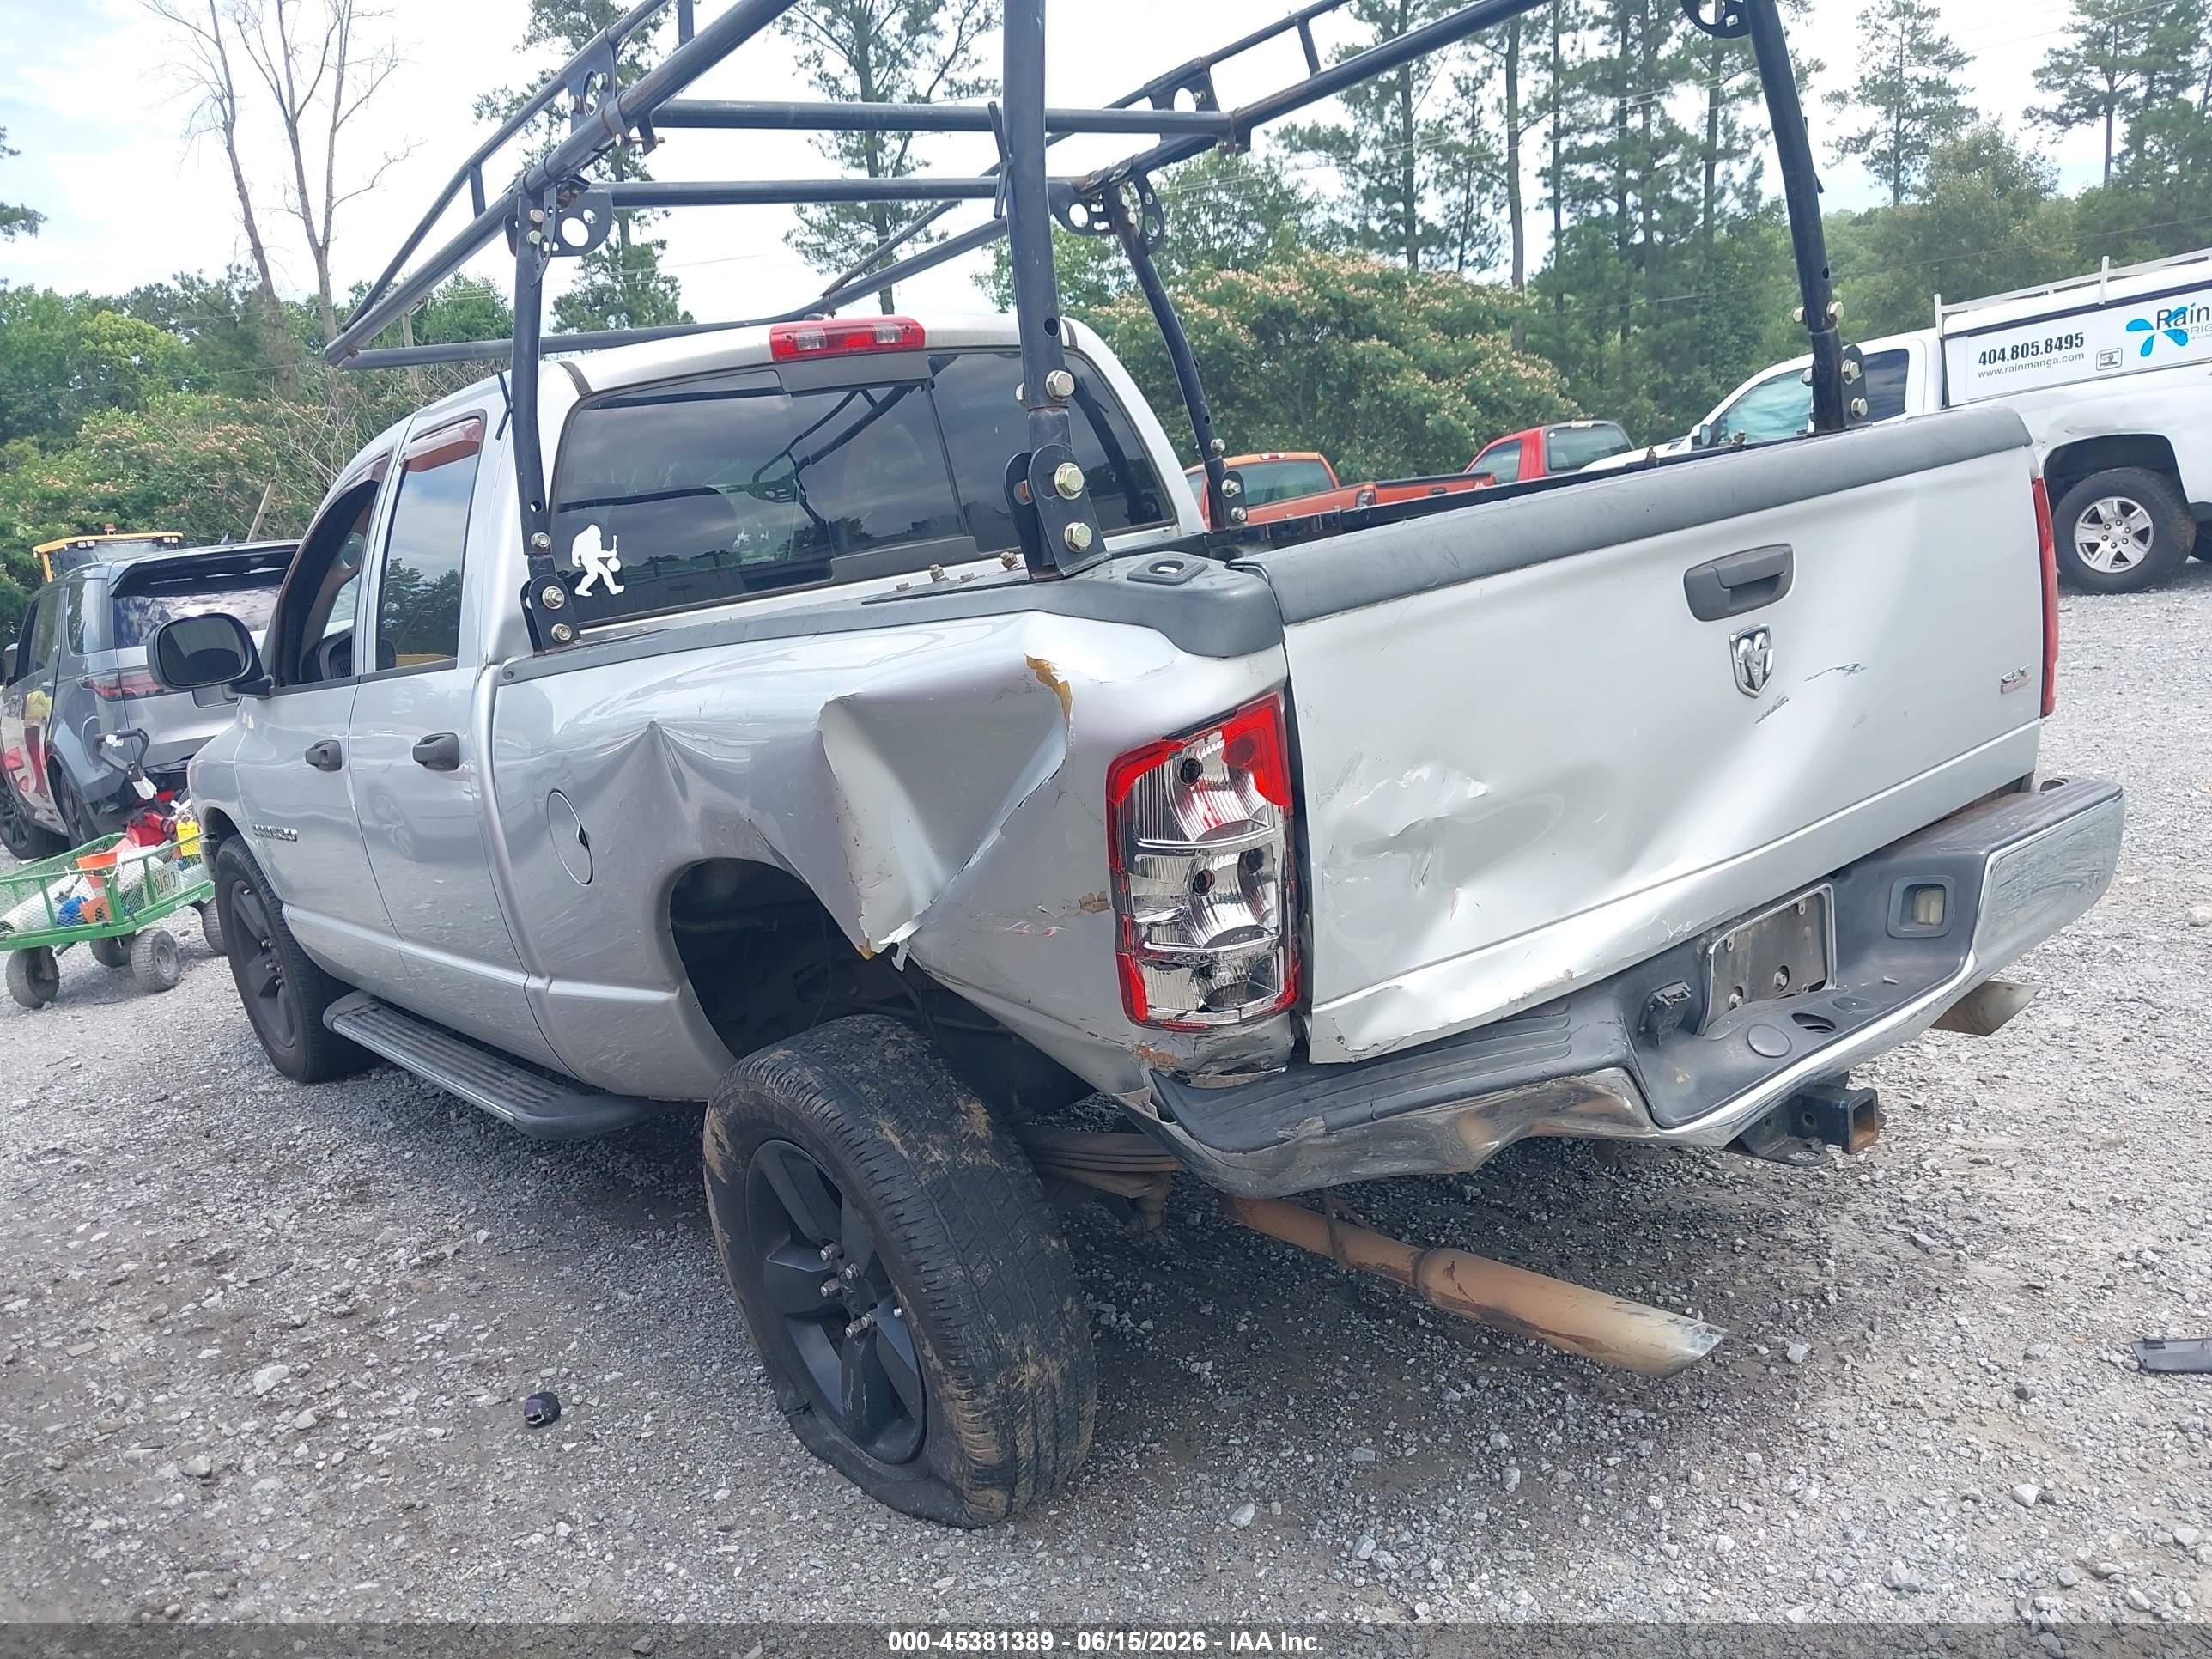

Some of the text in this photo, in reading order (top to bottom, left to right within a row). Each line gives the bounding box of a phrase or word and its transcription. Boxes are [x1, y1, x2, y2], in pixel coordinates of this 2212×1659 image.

[2156, 301, 2210, 331] Rain
[1978, 331, 2084, 366] 404.805.8495
[1978, 353, 2085, 378] www.rainmanga.com
